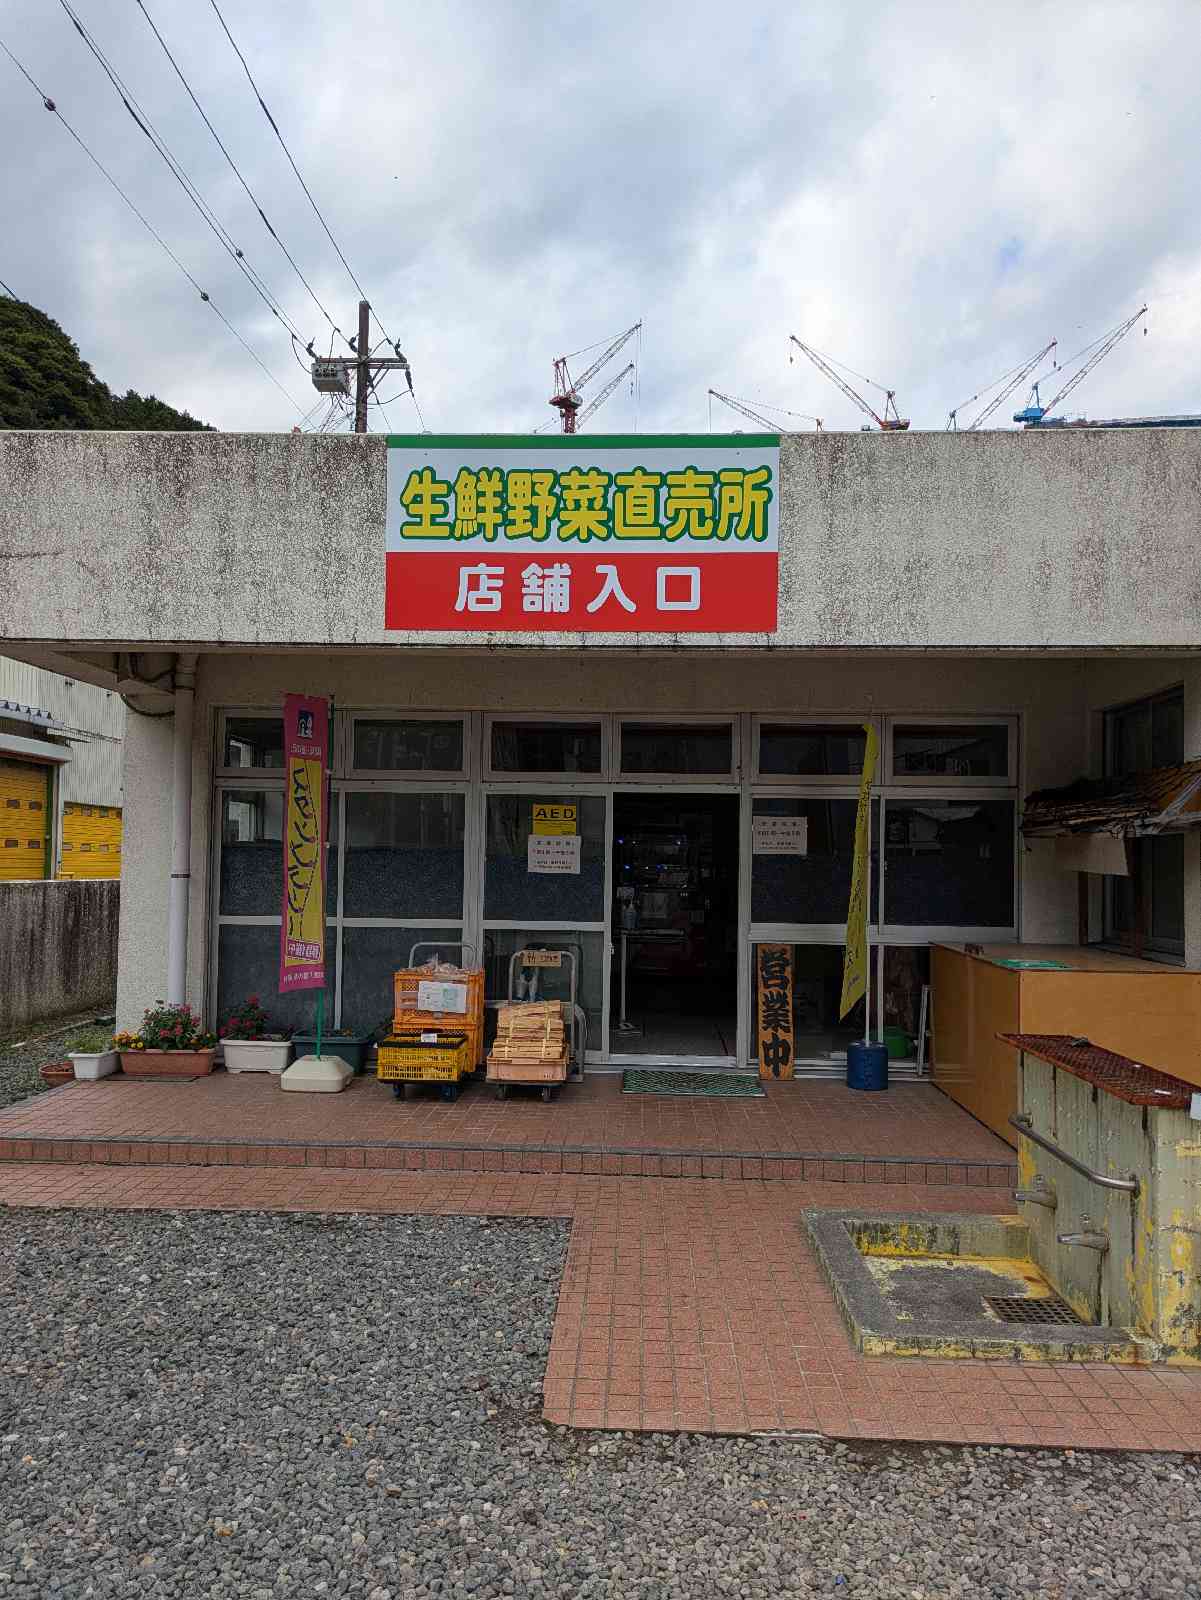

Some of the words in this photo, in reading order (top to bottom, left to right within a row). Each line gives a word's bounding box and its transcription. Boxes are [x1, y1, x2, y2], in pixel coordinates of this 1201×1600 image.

[401, 466, 771, 541] 生鮮野菜直売所
[454, 563, 701, 614] 店舗入口
[535, 808, 574, 819] AED
[760, 950, 792, 1078] 営業中
